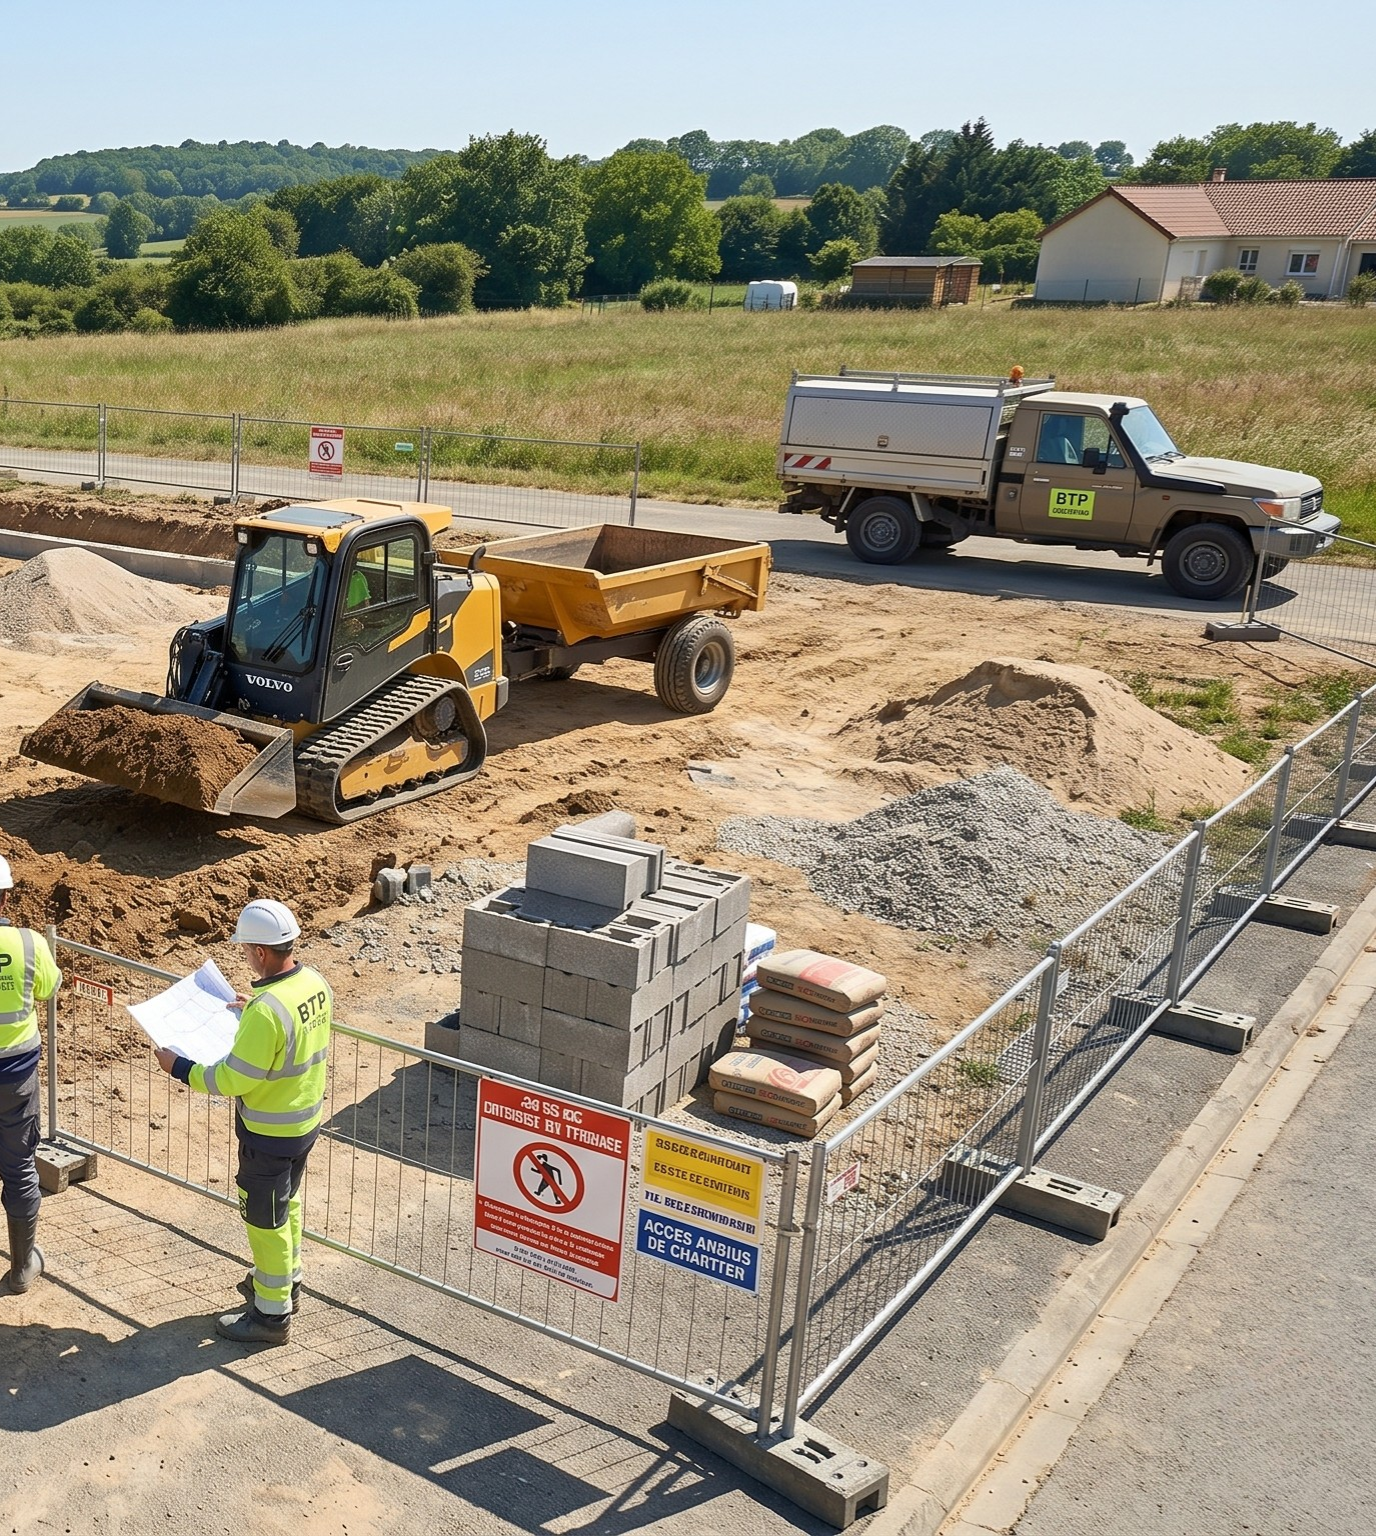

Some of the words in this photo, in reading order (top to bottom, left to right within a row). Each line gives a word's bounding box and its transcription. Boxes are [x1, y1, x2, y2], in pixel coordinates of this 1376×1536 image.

[1056, 492, 1089, 506] BTP
[245, 674, 293, 693] VOLVO
[297, 991, 326, 1024] BTP
[644, 1219, 693, 1246] ACCES
[648, 1236, 665, 1253] DE
